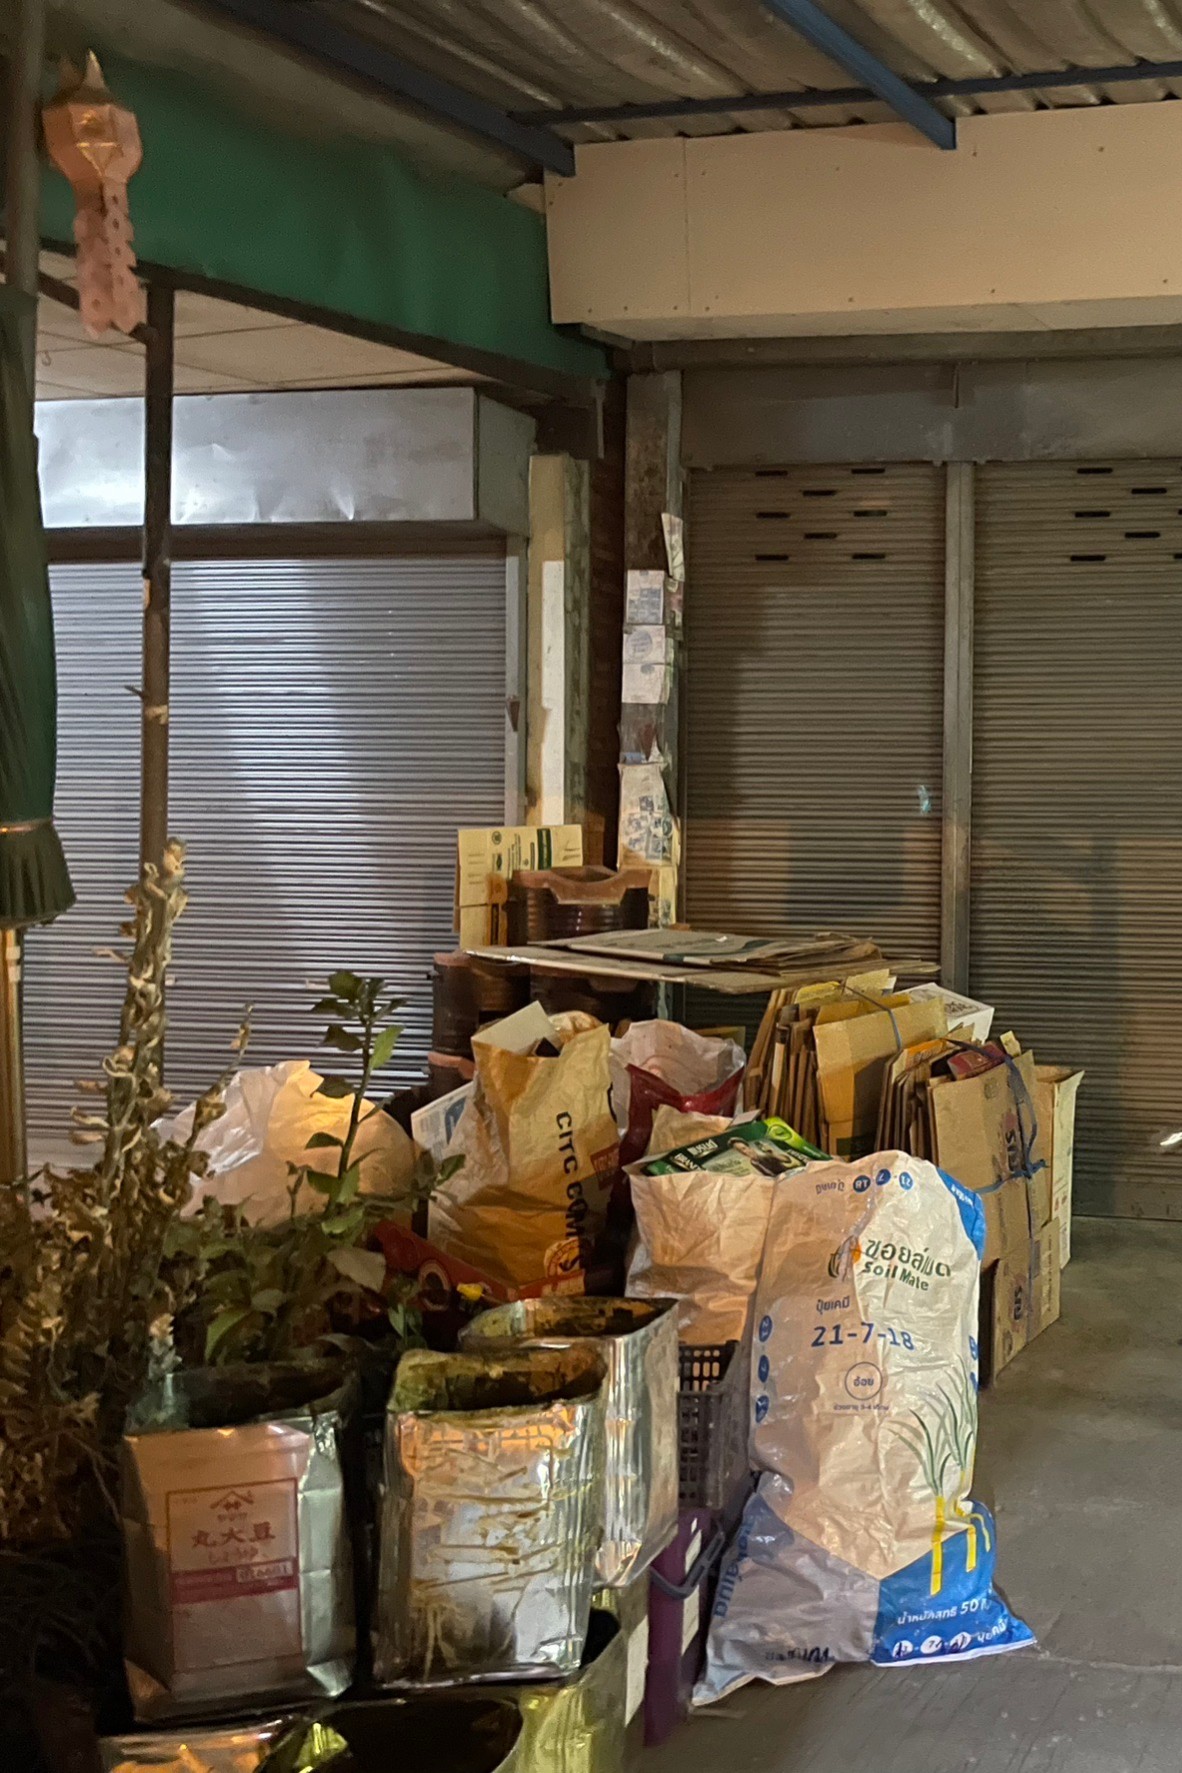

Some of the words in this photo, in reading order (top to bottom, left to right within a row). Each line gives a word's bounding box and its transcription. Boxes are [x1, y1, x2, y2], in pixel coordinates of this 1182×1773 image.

[556, 1111, 579, 1175] CITC
[862, 1261, 899, 1279] Soil
[898, 1267, 930, 1291] Mate
[816, 1295, 851, 1316] ปุ๋ยเคมี
[811, 1322, 915, 1350] 21-7-18
[853, 1376, 875, 1387] อ้อย
[191, 1521, 276, 1548] 丸大豆
[960, 1599, 979, 1615] 50
